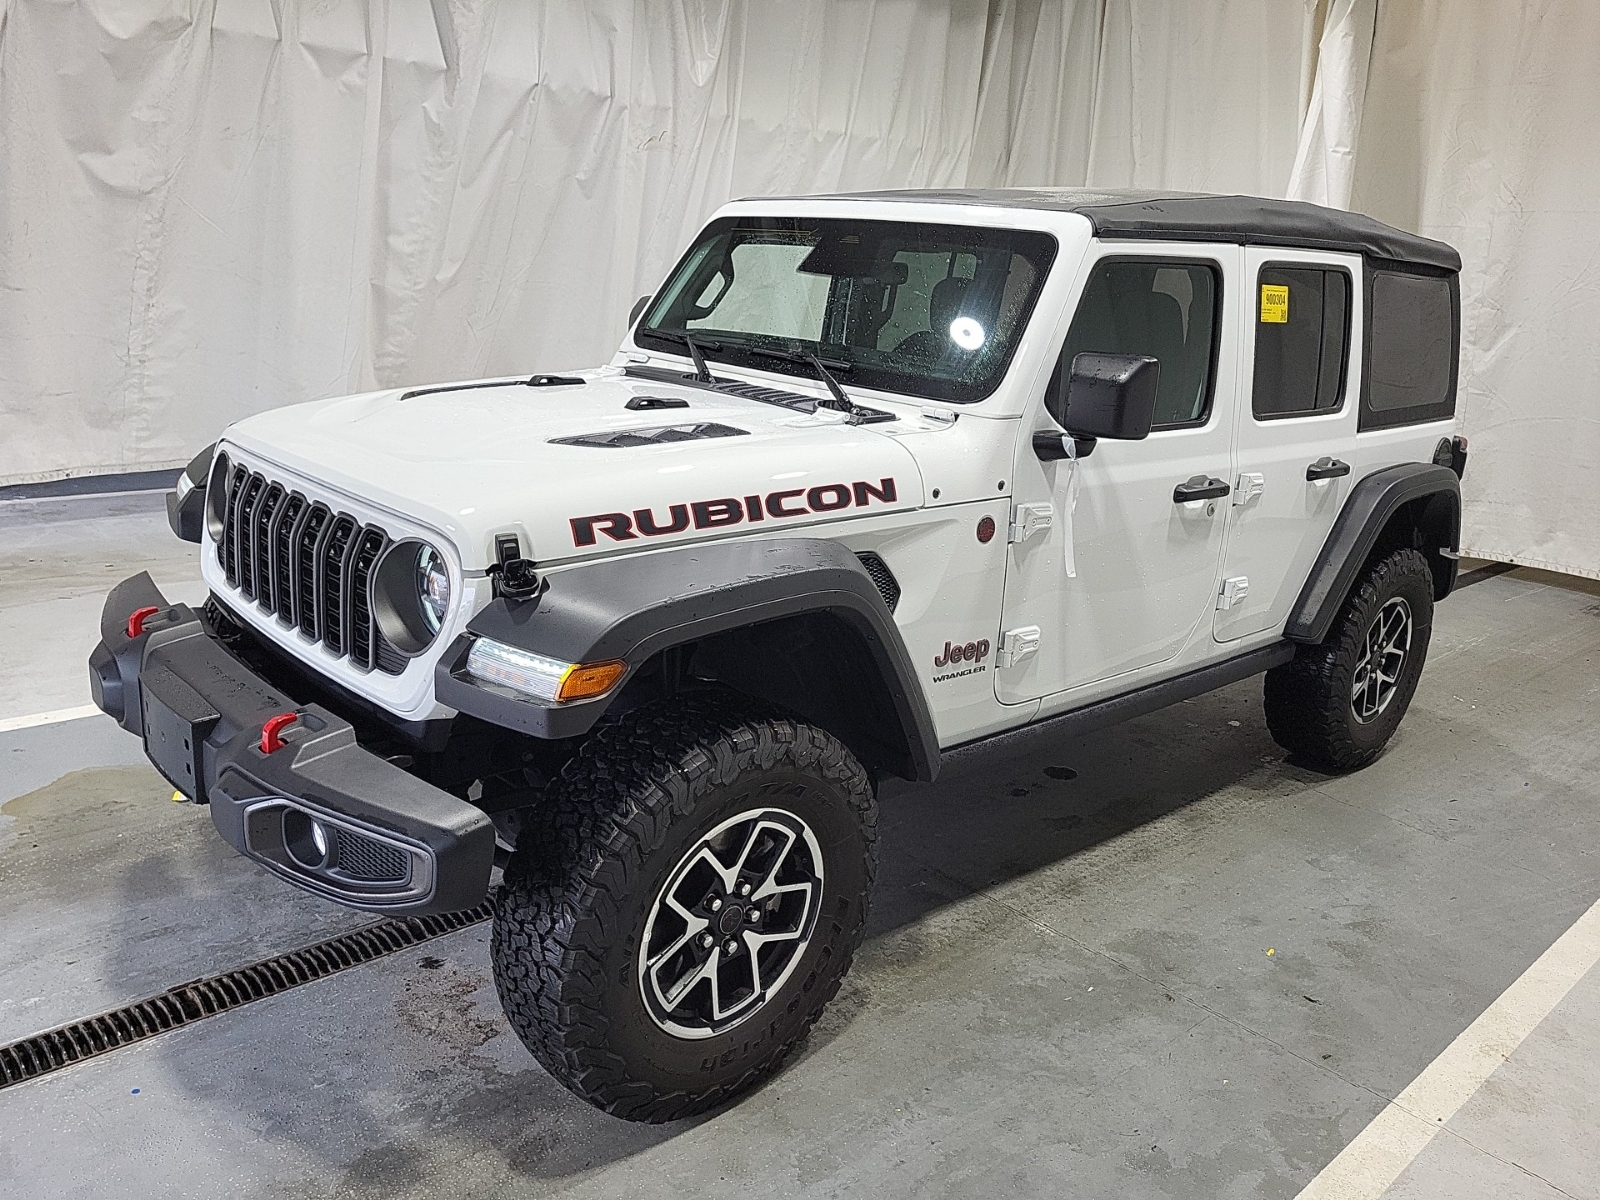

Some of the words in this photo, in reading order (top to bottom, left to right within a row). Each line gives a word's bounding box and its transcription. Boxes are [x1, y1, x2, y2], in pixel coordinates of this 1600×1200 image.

[569, 477, 897, 547] RUBICON
[934, 638, 990, 668] Jeep
[932, 665, 986, 683] WRANGLER
